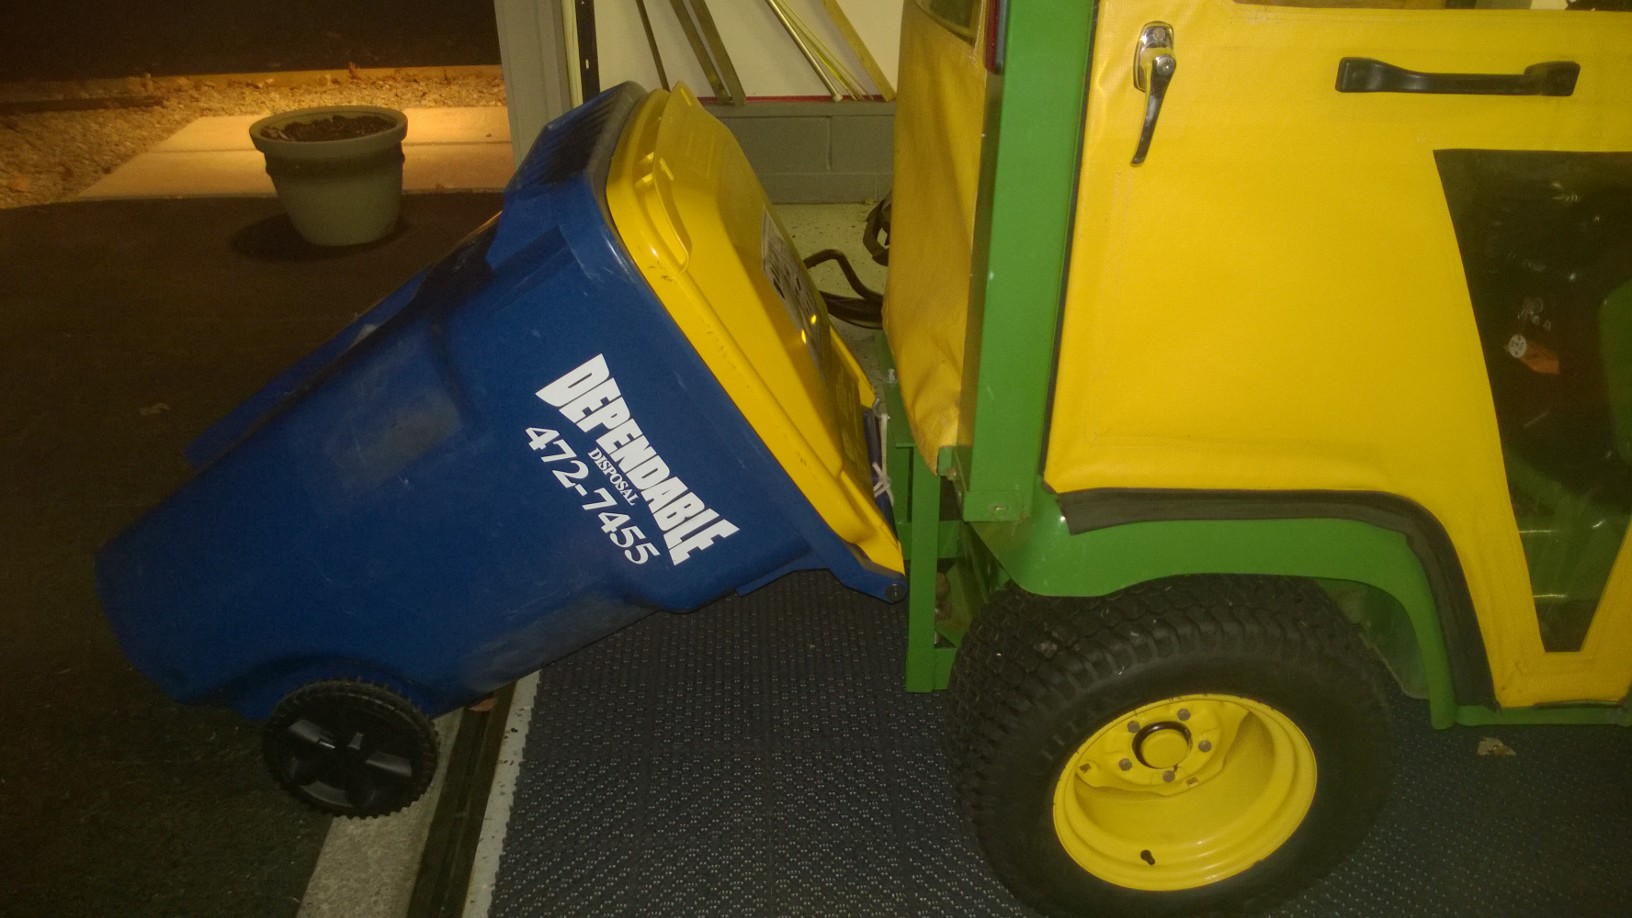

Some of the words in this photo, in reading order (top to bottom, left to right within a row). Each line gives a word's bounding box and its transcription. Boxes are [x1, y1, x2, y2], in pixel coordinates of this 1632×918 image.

[525, 427, 660, 565] 472-7455
[535, 353, 740, 566] DEPENDABLE
[588, 448, 641, 506] DISPOSAL
